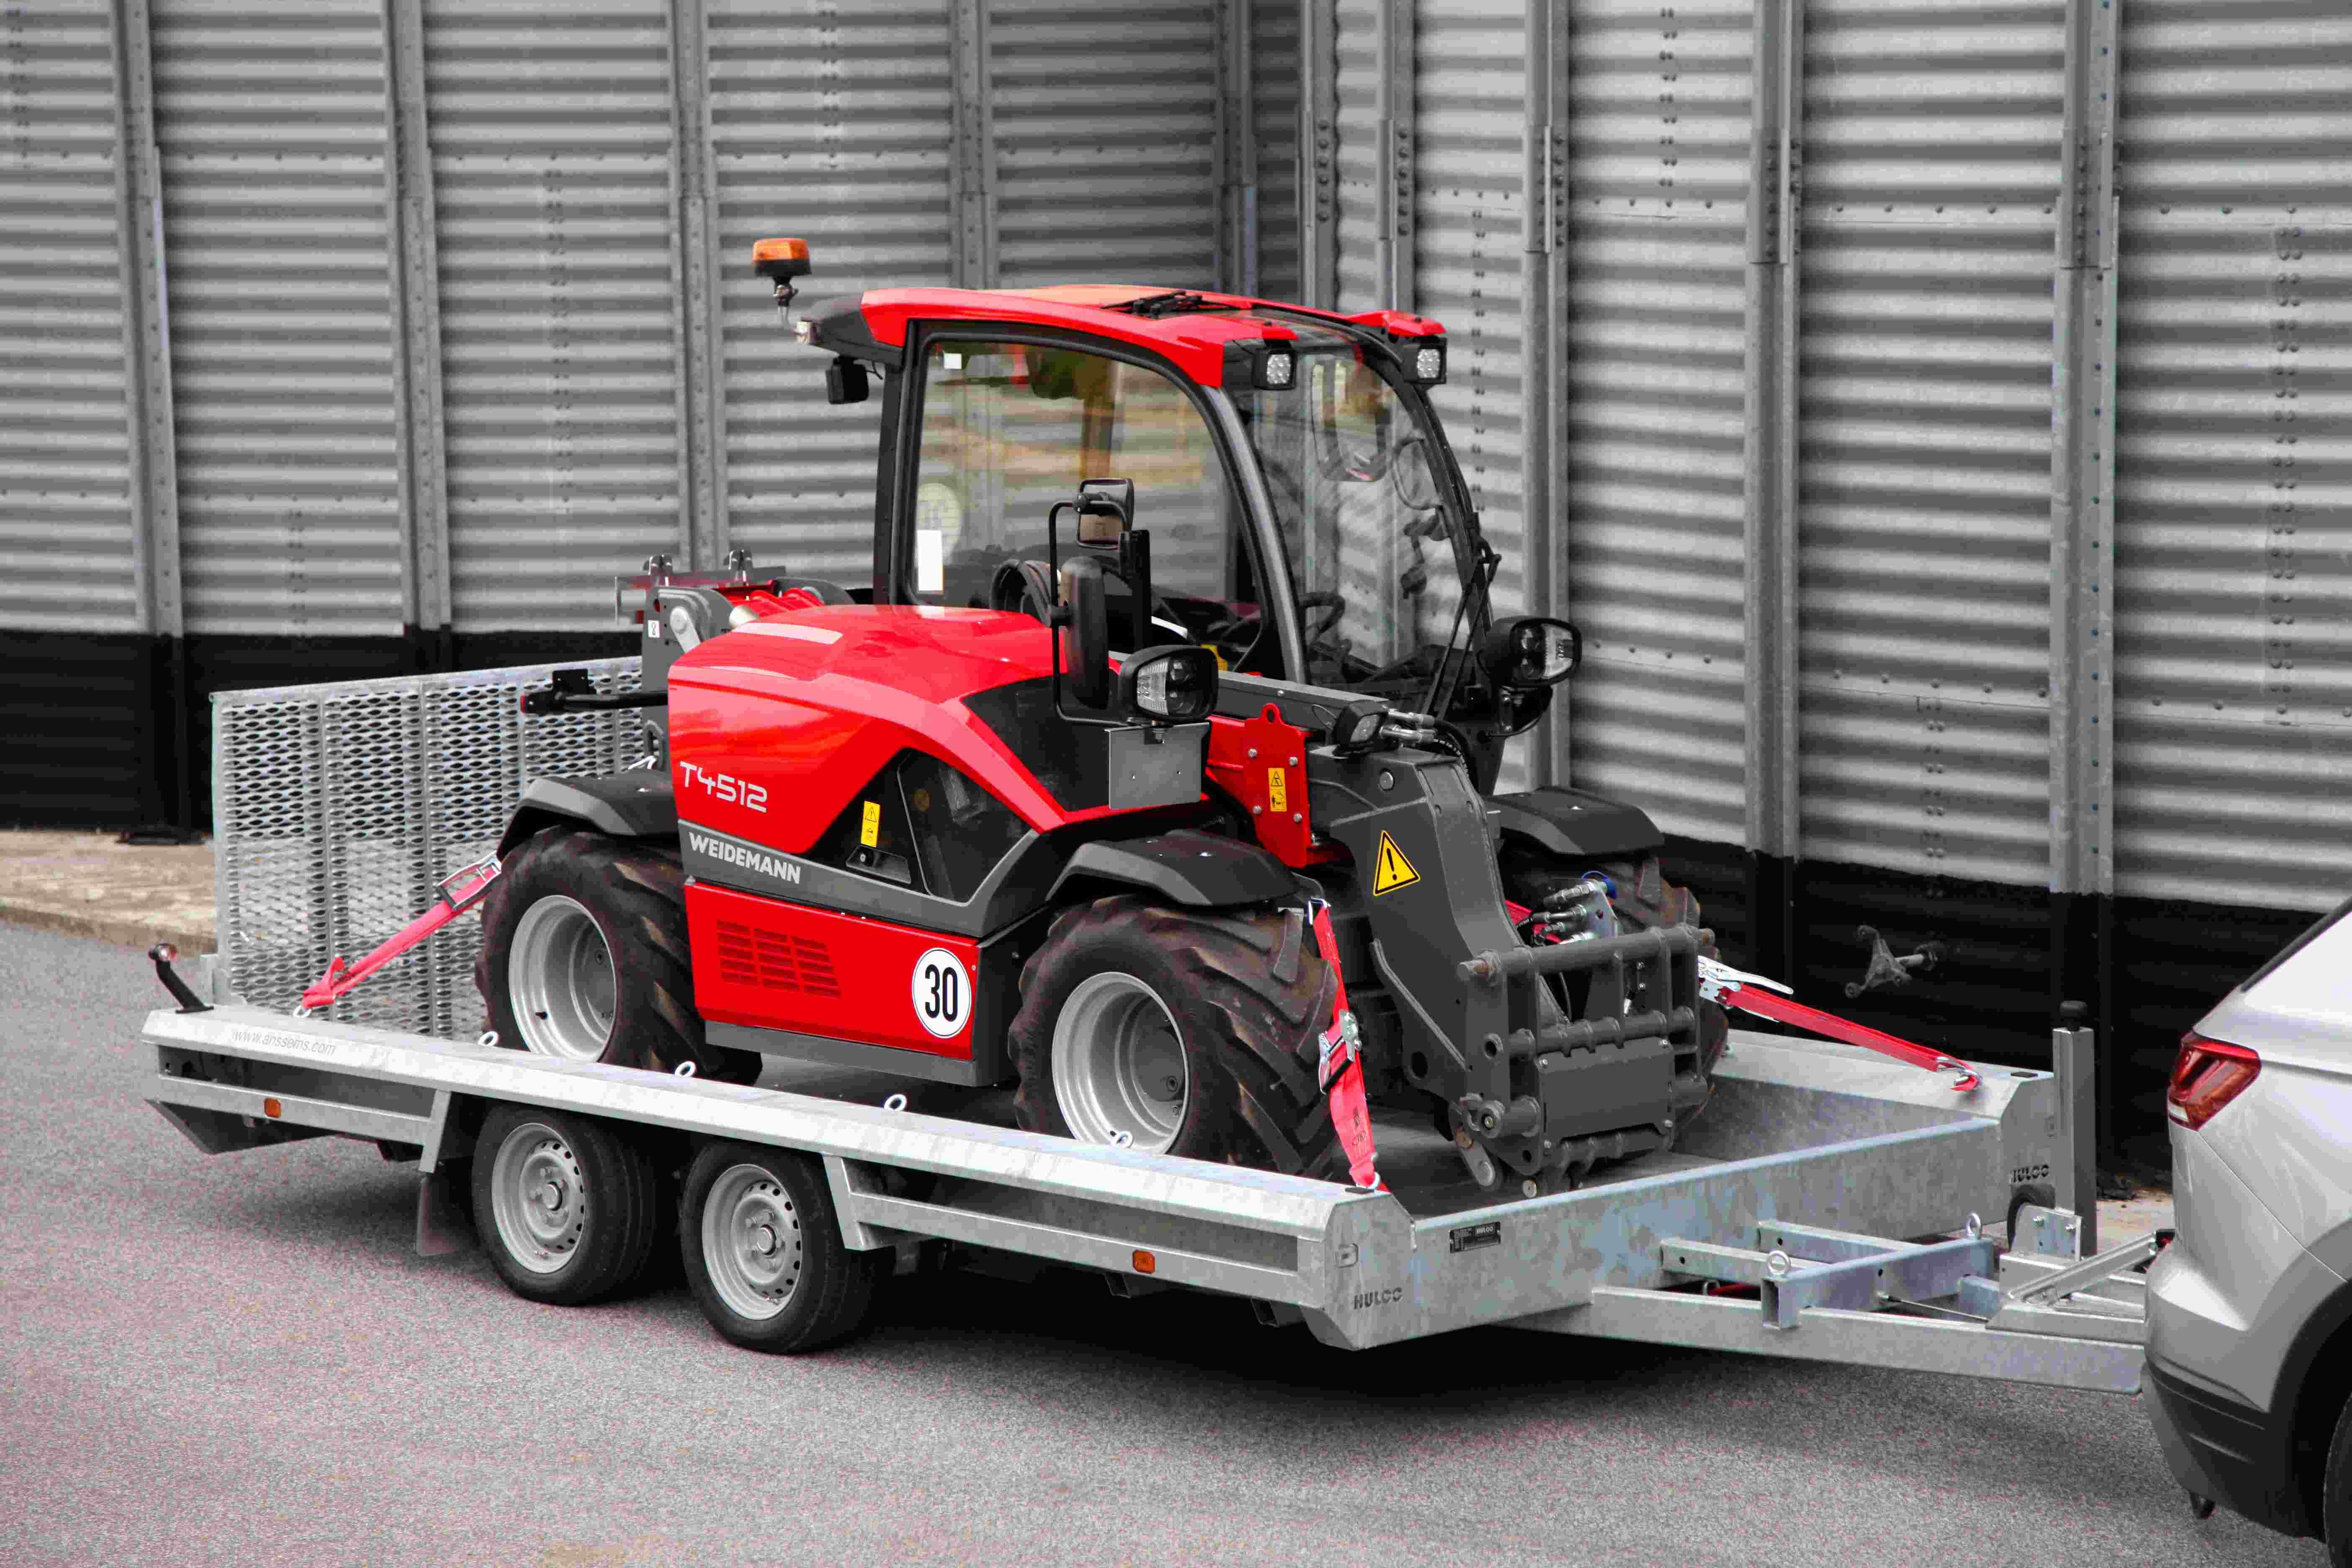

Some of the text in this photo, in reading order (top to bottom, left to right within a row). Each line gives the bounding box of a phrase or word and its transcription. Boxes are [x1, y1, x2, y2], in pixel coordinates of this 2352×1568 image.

[679, 761, 767, 813] T4512
[689, 832, 801, 884] WEIDEMANN
[925, 964, 958, 1022] 30
[232, 1031, 336, 1056] www.anssems.com
[1354, 1287, 1403, 1310] HULCO
